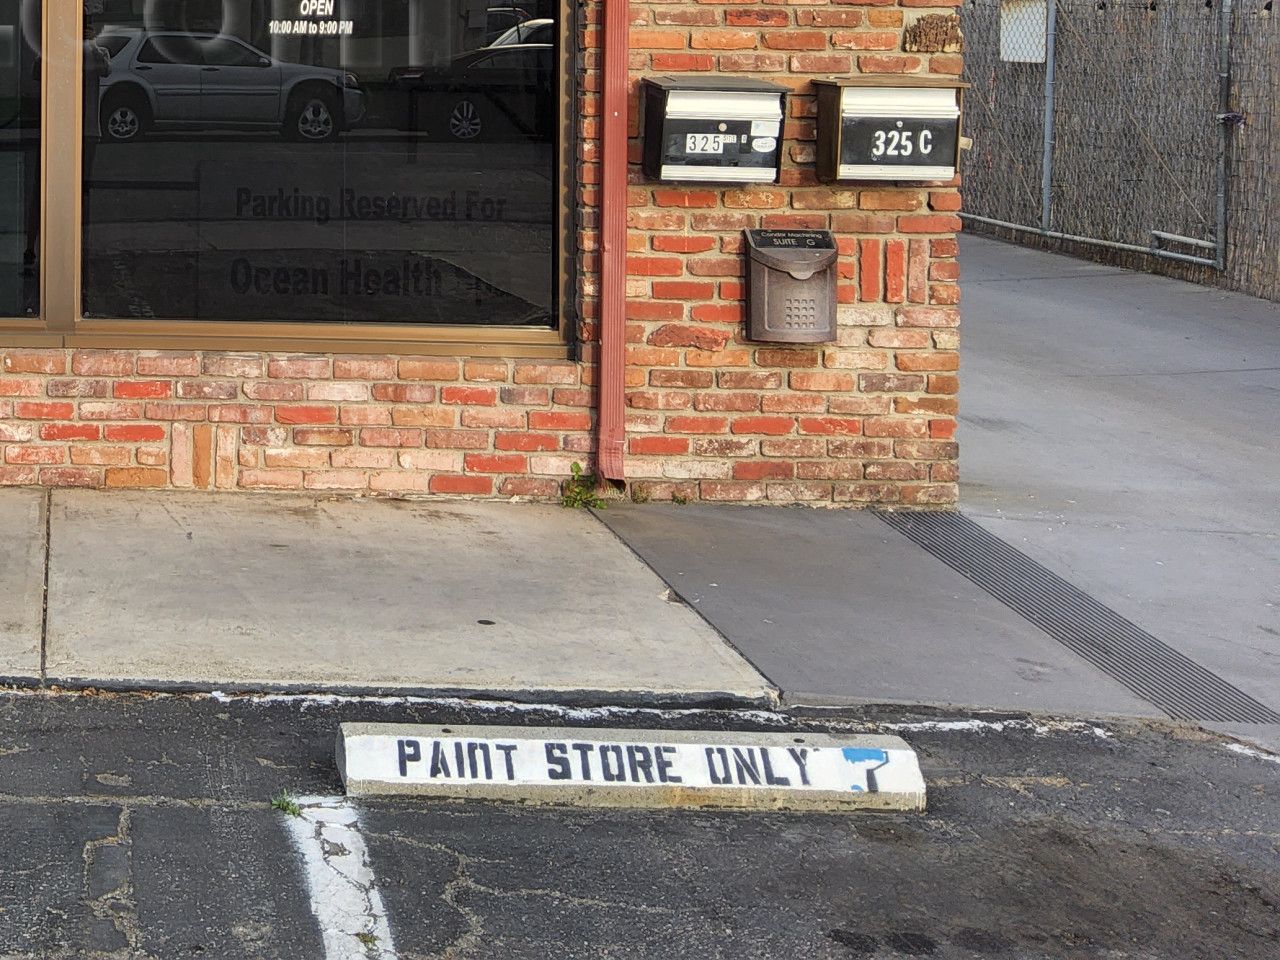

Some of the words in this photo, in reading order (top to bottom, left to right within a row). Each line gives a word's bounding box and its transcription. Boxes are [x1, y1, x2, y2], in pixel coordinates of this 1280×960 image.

[300, 0, 334, 16] OPEN
[269, 20, 291, 34] 10:00
[292, 20, 307, 34] AM
[309, 21, 318, 34] to
[319, 21, 337, 34] 9:00
[338, 21, 353, 35] PM
[688, 135, 720, 152] 325
[872, 130, 913, 156] 325
[919, 129, 932, 155] C
[235, 187, 330, 224] Parking
[339, 188, 456, 219] Reserved
[466, 191, 507, 220] For
[772, 238, 798, 246] SUITE
[230, 257, 328, 295] Ocean
[339, 258, 442, 296] Health
[397, 739, 518, 781] PAINT
[544, 742, 683, 784] STORE
[705, 747, 811, 786] ONLY
